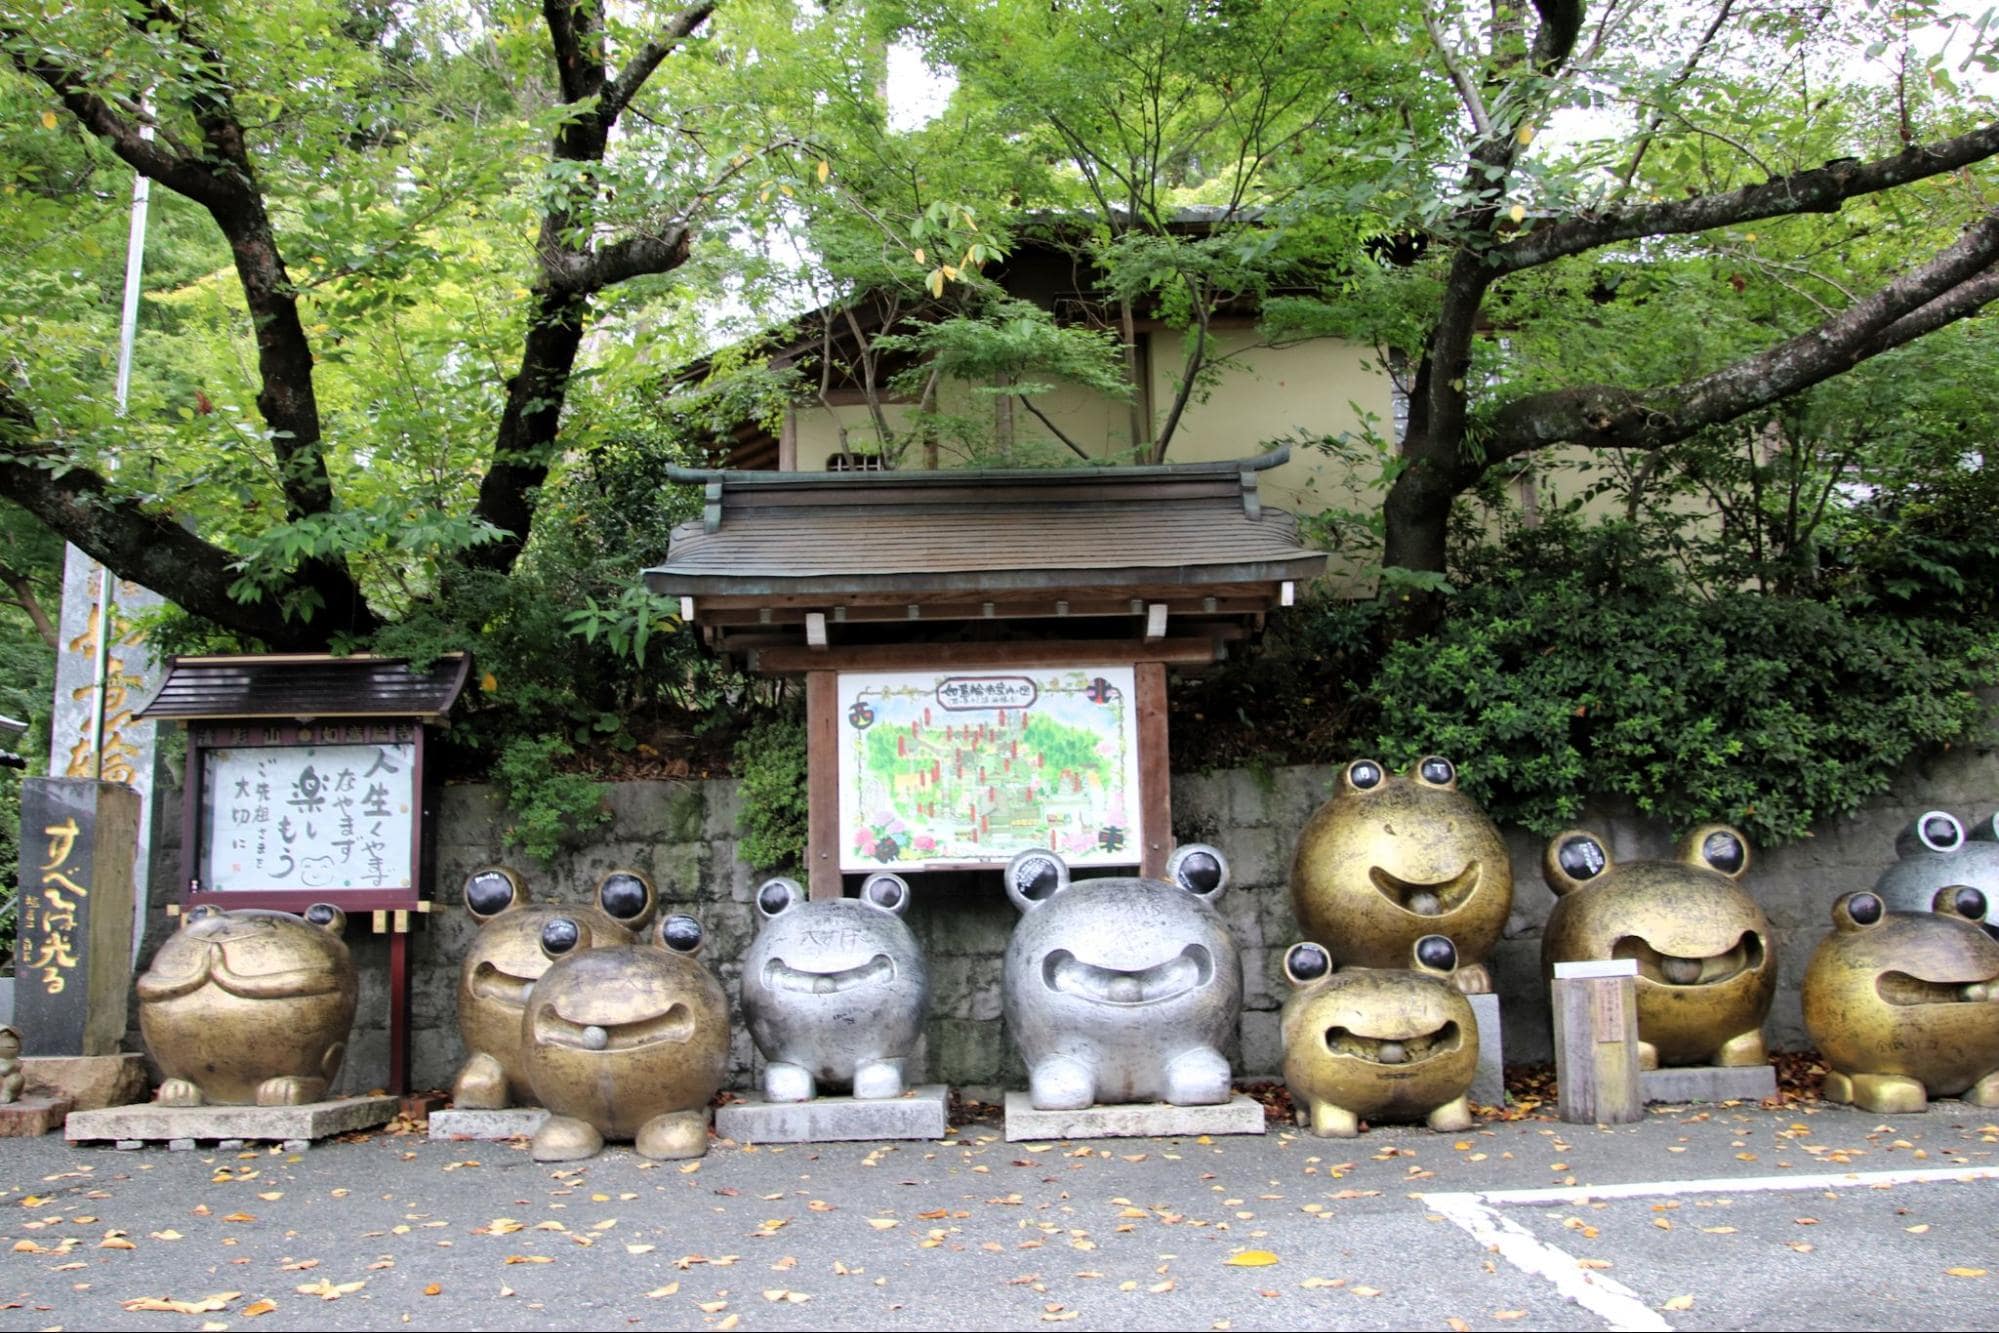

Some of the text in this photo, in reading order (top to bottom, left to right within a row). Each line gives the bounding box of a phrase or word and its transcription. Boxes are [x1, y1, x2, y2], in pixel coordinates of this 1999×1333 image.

[1087, 677, 1112, 704] 北
[848, 701, 874, 729] 西
[232, 775, 251, 850] 大切に
[331, 768, 363, 864] なやまず
[1098, 825, 1124, 853] 東
